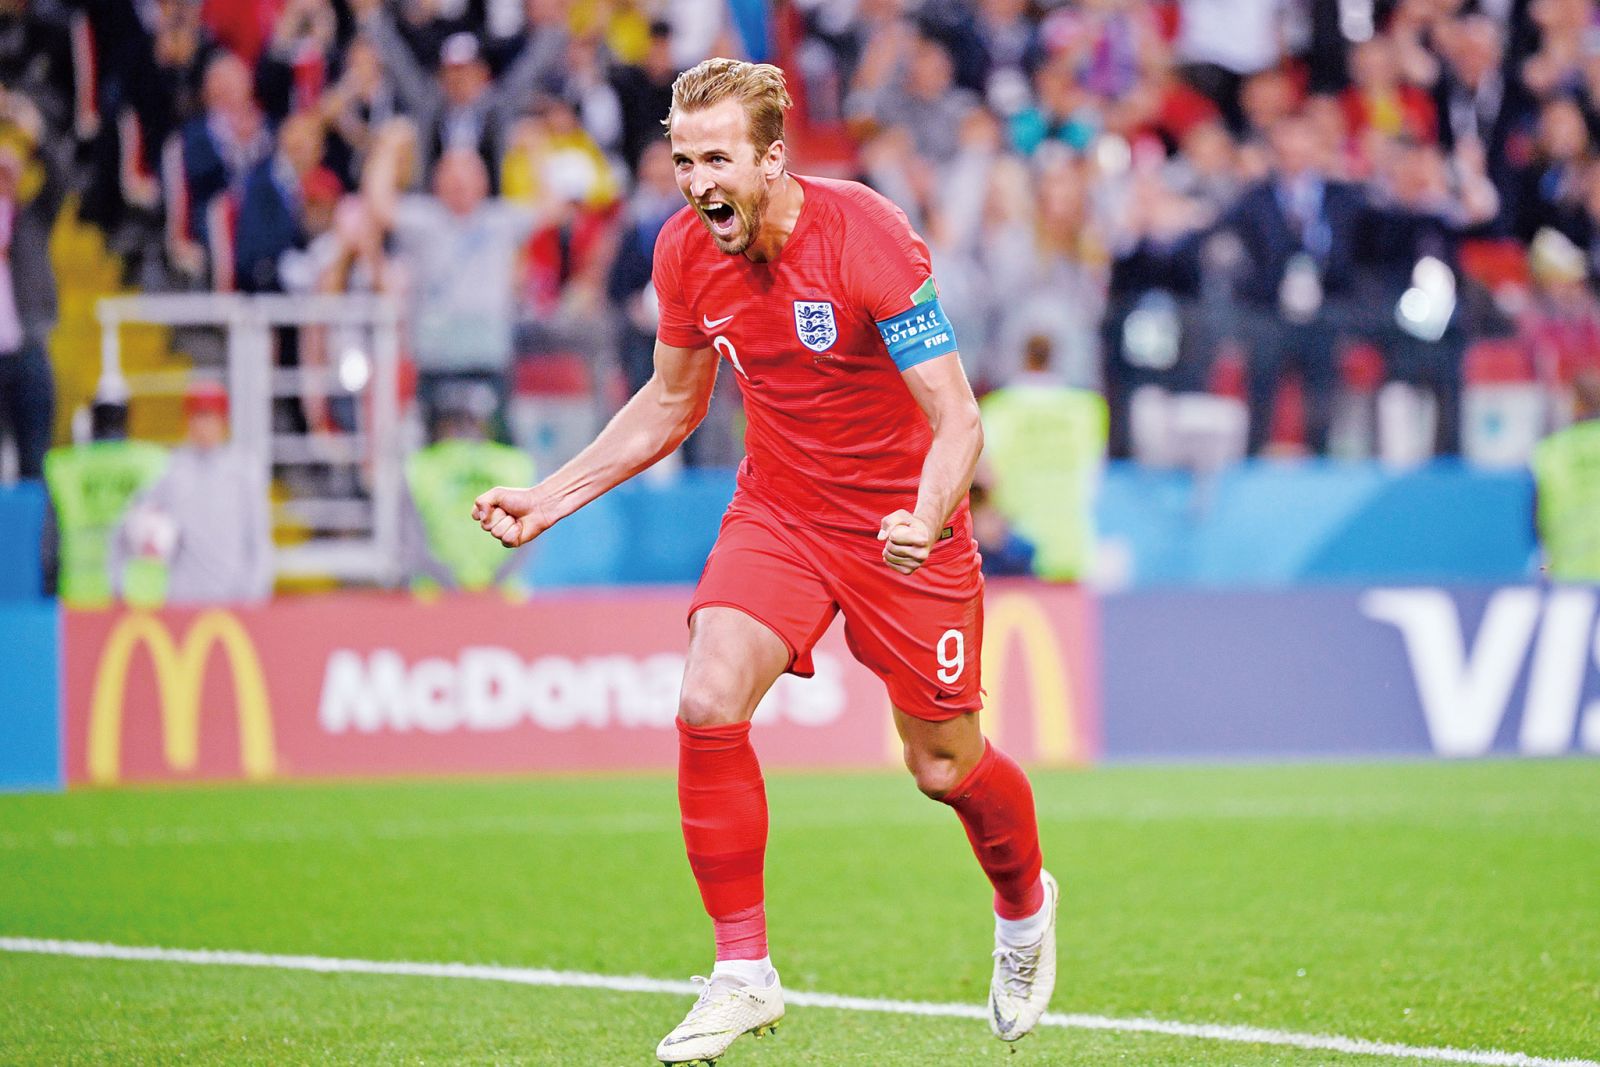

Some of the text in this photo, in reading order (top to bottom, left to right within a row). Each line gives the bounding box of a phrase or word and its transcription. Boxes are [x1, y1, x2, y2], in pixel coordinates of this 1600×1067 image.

[881, 310, 936, 336] IVING
[924, 333, 949, 349] FIFA
[937, 629, 965, 684] 9
[1361, 588, 1600, 756] VI
